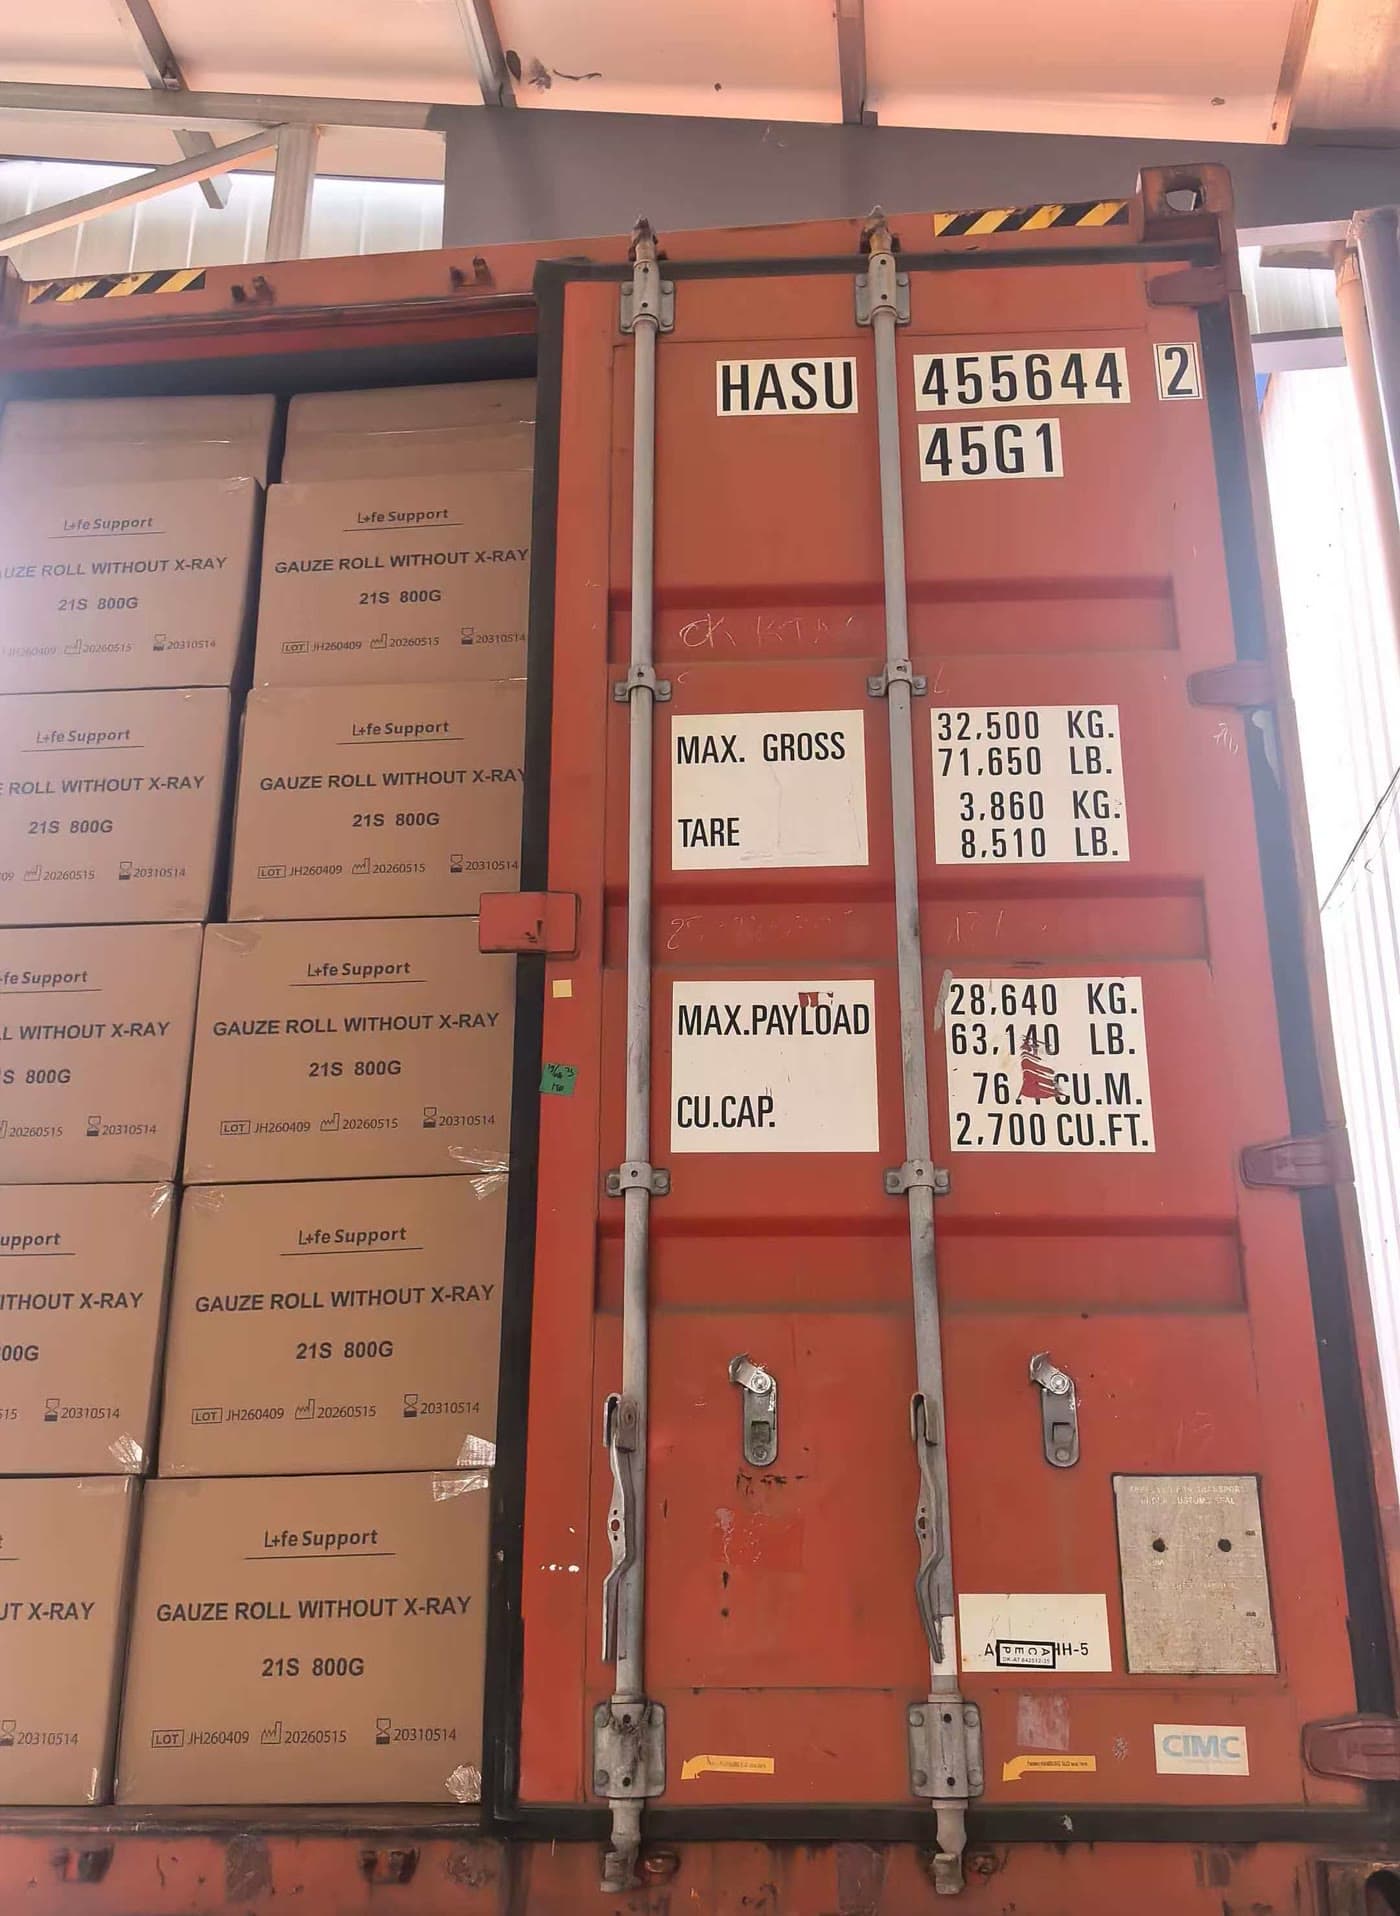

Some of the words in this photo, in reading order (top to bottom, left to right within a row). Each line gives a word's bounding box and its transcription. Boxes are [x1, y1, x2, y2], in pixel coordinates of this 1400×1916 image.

[722, 361, 852, 411] HASU
[922, 353, 1122, 406] 455644
[1164, 348, 1193, 395] 2
[925, 423, 1053, 476] 45G1
[93, 518, 152, 532] Support
[388, 509, 448, 524] Support
[41, 563, 86, 578] ROLL
[92, 560, 170, 574] WITHOUT
[174, 557, 227, 571] X-RAY
[275, 559, 334, 573] GAUZE
[339, 557, 384, 570] ROLL
[390, 552, 470, 567] WITHOUT
[474, 549, 528, 563] X-RAY
[58, 598, 88, 611] 21S
[97, 597, 138, 610] 800G
[359, 592, 390, 605] 21S
[400, 590, 441, 603] 800G
[166, 640, 215, 651] 20310514
[286, 642, 306, 652] LOT
[312, 641, 362, 652] JH260409
[389, 635, 439, 648] 20260515
[476, 632, 526, 644] 20310514
[384, 722, 448, 738] Support
[938, 711, 1038, 741] 32,500
[1068, 710, 1114, 738] KG.
[67, 730, 130, 745] Support
[678, 735, 745, 764] MAX.
[763, 732, 845, 761] GROSS
[938, 747, 1041, 776] 71,650
[1070, 746, 1112, 774] LB.
[9, 781, 56, 795] ROLL
[62, 778, 144, 793] WITHOUT
[148, 776, 204, 790] X-RAY
[260, 776, 322, 790] GAUZE
[328, 774, 376, 788] ROLL
[382, 771, 467, 786] WITHOUT
[960, 791, 1043, 821] 3,860
[1073, 790, 1121, 819] KG.
[28, 821, 60, 834] 21S
[70, 820, 112, 833] 800G
[352, 814, 384, 827] 21S
[396, 813, 439, 826] 800G
[678, 818, 739, 847] TARE
[962, 828, 1045, 858] 8,510
[1075, 827, 1118, 856] LB.
[43, 870, 95, 880] 20260515
[133, 866, 186, 879] 20310514
[261, 866, 282, 877] LOT
[288, 864, 342, 876] JH260409
[372, 864, 426, 874] 20260515
[466, 859, 518, 871] 20310514
[21, 971, 88, 987] Support
[342, 963, 410, 979] Support
[951, 983, 1057, 1015] 28,640
[1088, 983, 1137, 1014] KG.
[213, 1020, 280, 1036] GAUZE
[286, 1019, 337, 1034] ROLL
[344, 1015, 434, 1032] WITHOUT
[438, 1013, 499, 1029] X-RAY
[679, 1001, 869, 1035] MAX.PAYLOAD
[20, 1024, 106, 1040] WITHOUT
[111, 1022, 170, 1037] X-RAY
[952, 1023, 1059, 1055] 63,140
[1090, 1023, 1135, 1055] LB.
[25, 1069, 70, 1084] 800G
[309, 1062, 343, 1077] 21S
[354, 1060, 401, 1076] 800G
[973, 1072, 1042, 1105] 76.
[1054, 1072, 1142, 1105] CU.M.
[678, 1095, 775, 1128] CU.CAP.
[9, 1126, 63, 1137] 20260515
[102, 1124, 156, 1135] 20310514
[223, 1123, 245, 1134] LOT
[254, 1122, 311, 1133] JH260409
[342, 1117, 399, 1129] 20260515
[438, 1115, 494, 1128] 20310514
[957, 1113, 1045, 1145] 2,700
[1057, 1113, 1148, 1146] CU.FT.
[334, 1228, 407, 1246] Support
[80, 1292, 143, 1309] X-RAY
[196, 1294, 264, 1312] GAUZE
[270, 1292, 324, 1310] ROLL
[331, 1288, 425, 1307] WITHOUT
[431, 1284, 494, 1303] X-RAY
[296, 1342, 332, 1359] 21S
[344, 1341, 392, 1358] 800G
[60, 1407, 119, 1419] 20310514
[195, 1411, 217, 1422] LOT
[226, 1408, 284, 1421] JH260409
[316, 1405, 376, 1418] 20260515
[420, 1402, 479, 1415] 20310514
[302, 1530, 378, 1551] Support
[28, 1602, 95, 1620] X-RAY
[157, 1603, 228, 1621] GAUZE
[235, 1601, 291, 1620] ROLL
[299, 1598, 398, 1618] WITHOUT
[404, 1596, 471, 1616] X-RAY
[262, 1658, 299, 1677] 21S
[312, 1658, 364, 1676] 800G
[17, 1731, 78, 1747] 20310514
[156, 1734, 179, 1744] LOT
[187, 1731, 249, 1744] JH260409
[284, 1730, 347, 1744] 20260515
[393, 1727, 456, 1743] 20310514
[1163, 1735, 1240, 1758] CIMC
